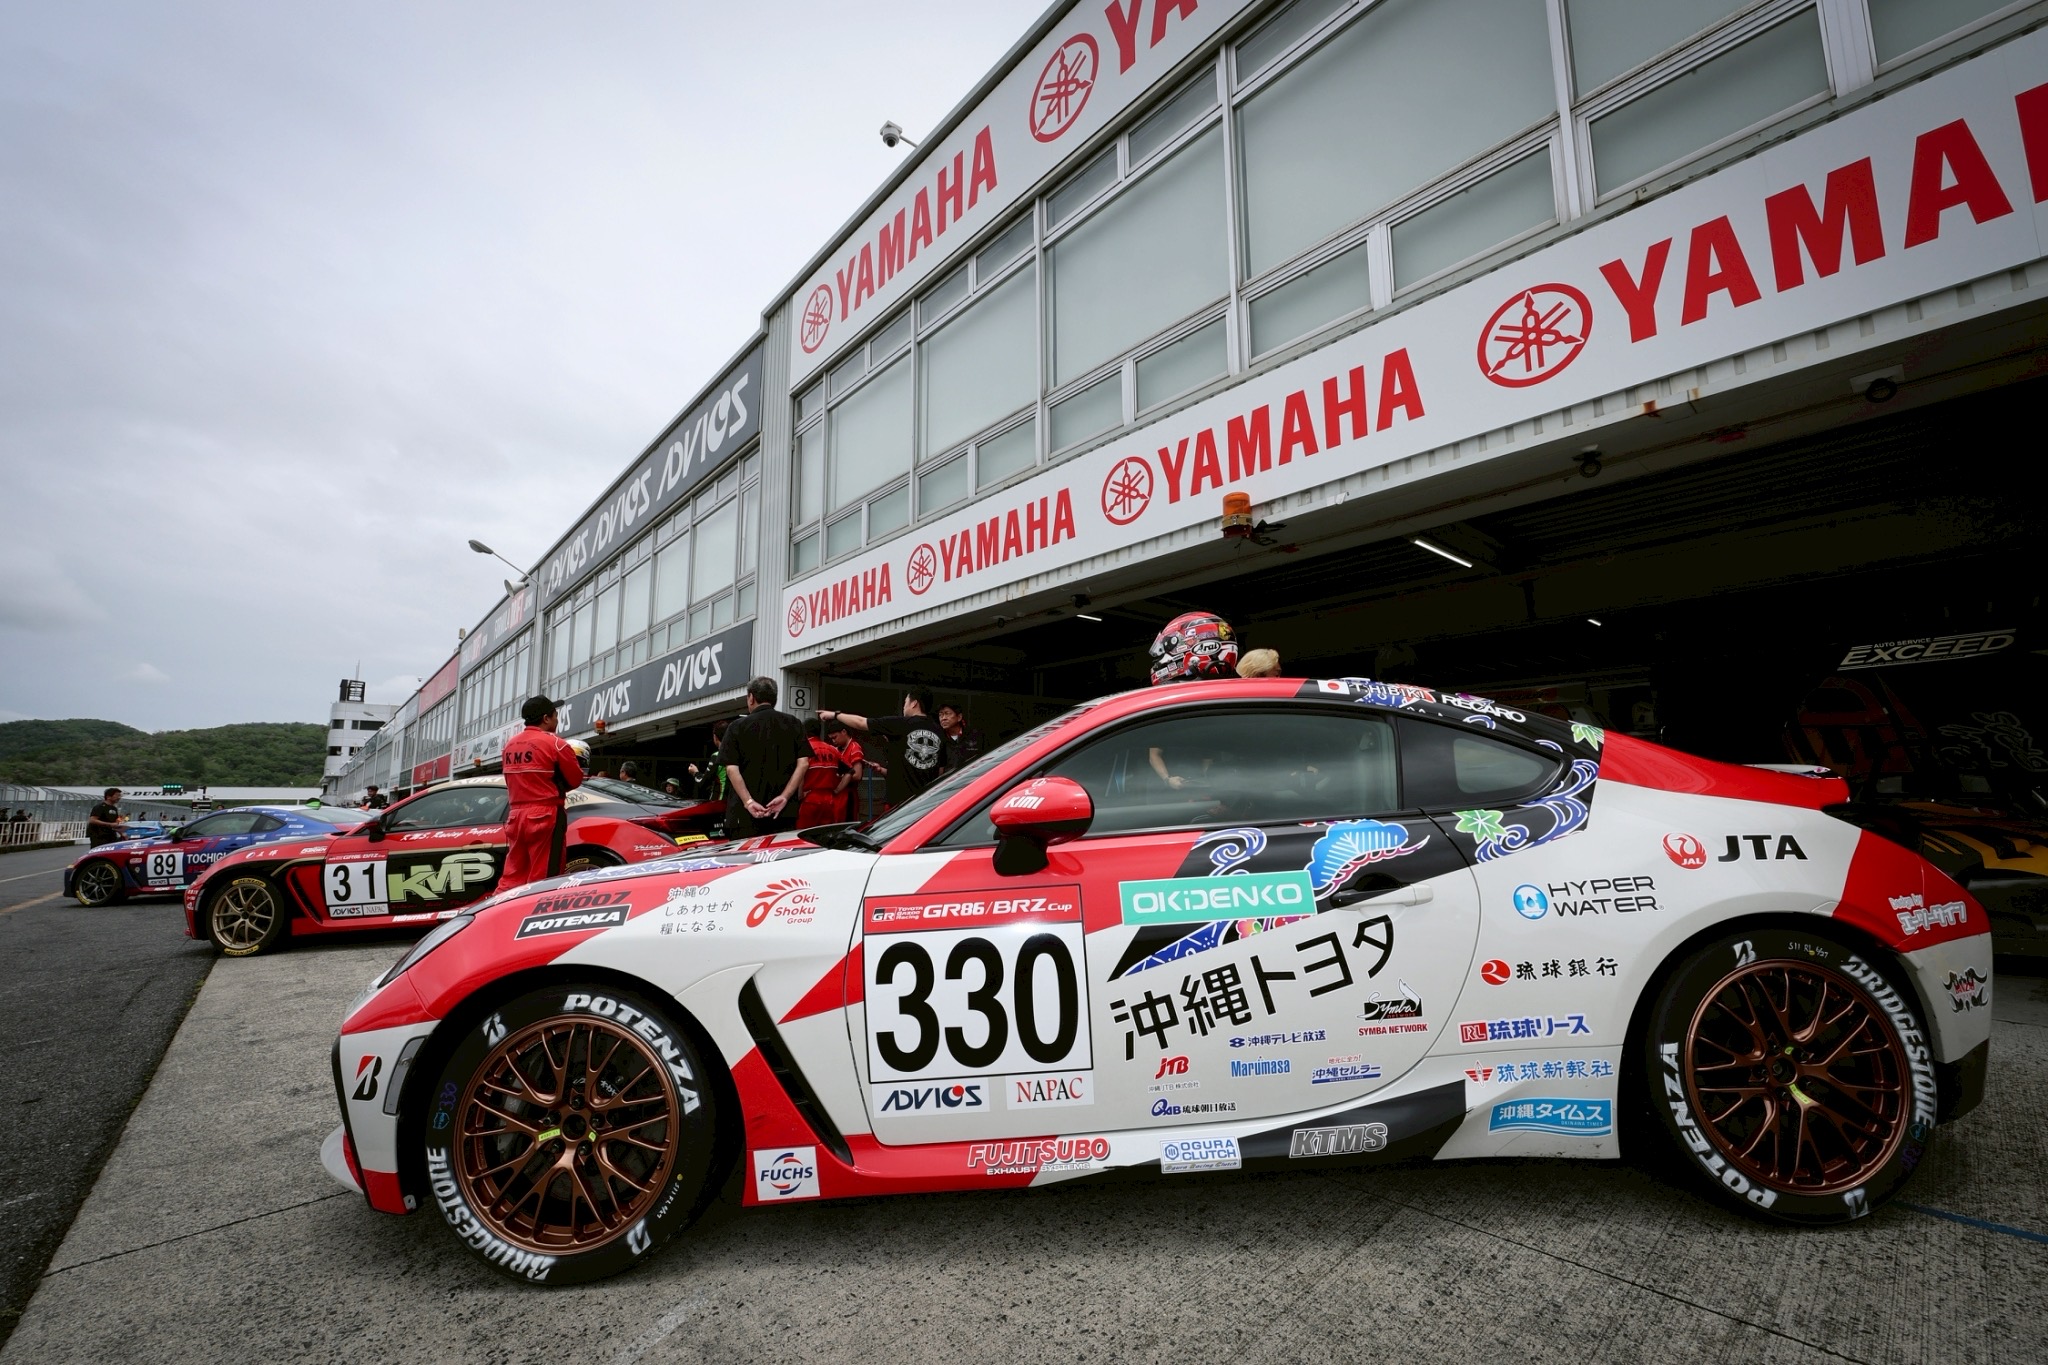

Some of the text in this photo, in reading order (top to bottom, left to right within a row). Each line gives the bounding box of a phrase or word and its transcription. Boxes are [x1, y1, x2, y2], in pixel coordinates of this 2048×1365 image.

[835, 124, 998, 322] YAMAHA
[1157, 347, 1425, 504] YAMAHA
[940, 488, 1076, 582] YAMAHA
[809, 562, 892, 628] YAMAHA
[1197, 643, 1217, 651] Arai
[1840, 635, 2015, 666] EXCEED
[1874, 637, 1931, 649] AUTO SERVICE
[795, 689, 805, 708] 8
[1442, 694, 1526, 723] RECARO
[187, 852, 227, 865] TOCHIG
[1718, 835, 1808, 862] JTA
[154, 853, 176, 876] 89
[1681, 857, 1703, 866] JAL
[333, 863, 376, 902] 31
[388, 852, 494, 903] KMS
[1547, 876, 1656, 897] HYPER
[531, 891, 632, 915] RW007
[668, 886, 710, 900] 沖縄の
[366, 905, 386, 914] NAPAC
[665, 901, 734, 917] しあわせが
[774, 906, 816, 917] Shoku
[872, 913, 895, 921] GR
[1048, 903, 1072, 913] Cup
[1553, 895, 1658, 917] WATER
[524, 911, 621, 933] POTENZA
[660, 920, 724, 936] 糧になる。
[1516, 957, 1618, 980] 琉球銀行
[1109, 914, 1395, 1061] 沖縄トヨタ
[875, 932, 1079, 1072] 330
[1248, 1030, 1326, 1047] 沖縄テレビ放送
[1359, 1023, 1428, 1036] SYMBA NETWORK
[1488, 1015, 1590, 1041] 琉球リース
[1841, 955, 1937, 1129] BRIDGESTONE
[563, 993, 700, 1116] POTENZA
[1155, 1056, 1189, 1079] JTB
[1312, 1064, 1380, 1079] 沖縄セルラー
[1497, 1060, 1614, 1083] 琉球新報社
[1016, 1078, 1083, 1103] NAPAC
[1182, 1102, 1236, 1114] 琉球朝日放送
[1499, 1103, 1604, 1121] 沖縄タイムス
[1660, 1042, 1778, 1210] POTENZA
[968, 1136, 1110, 1167] FUJITSUBO
[1180, 1139, 1234, 1151] OGURA
[1289, 1122, 1388, 1159] KTMS
[1182, 1149, 1237, 1161] CLUTCH
[760, 1167, 813, 1181] FUCHS
[987, 1162, 1090, 1176] EXHAUST SYSTEMS
[427, 1147, 556, 1280] BRIDGESTONE
